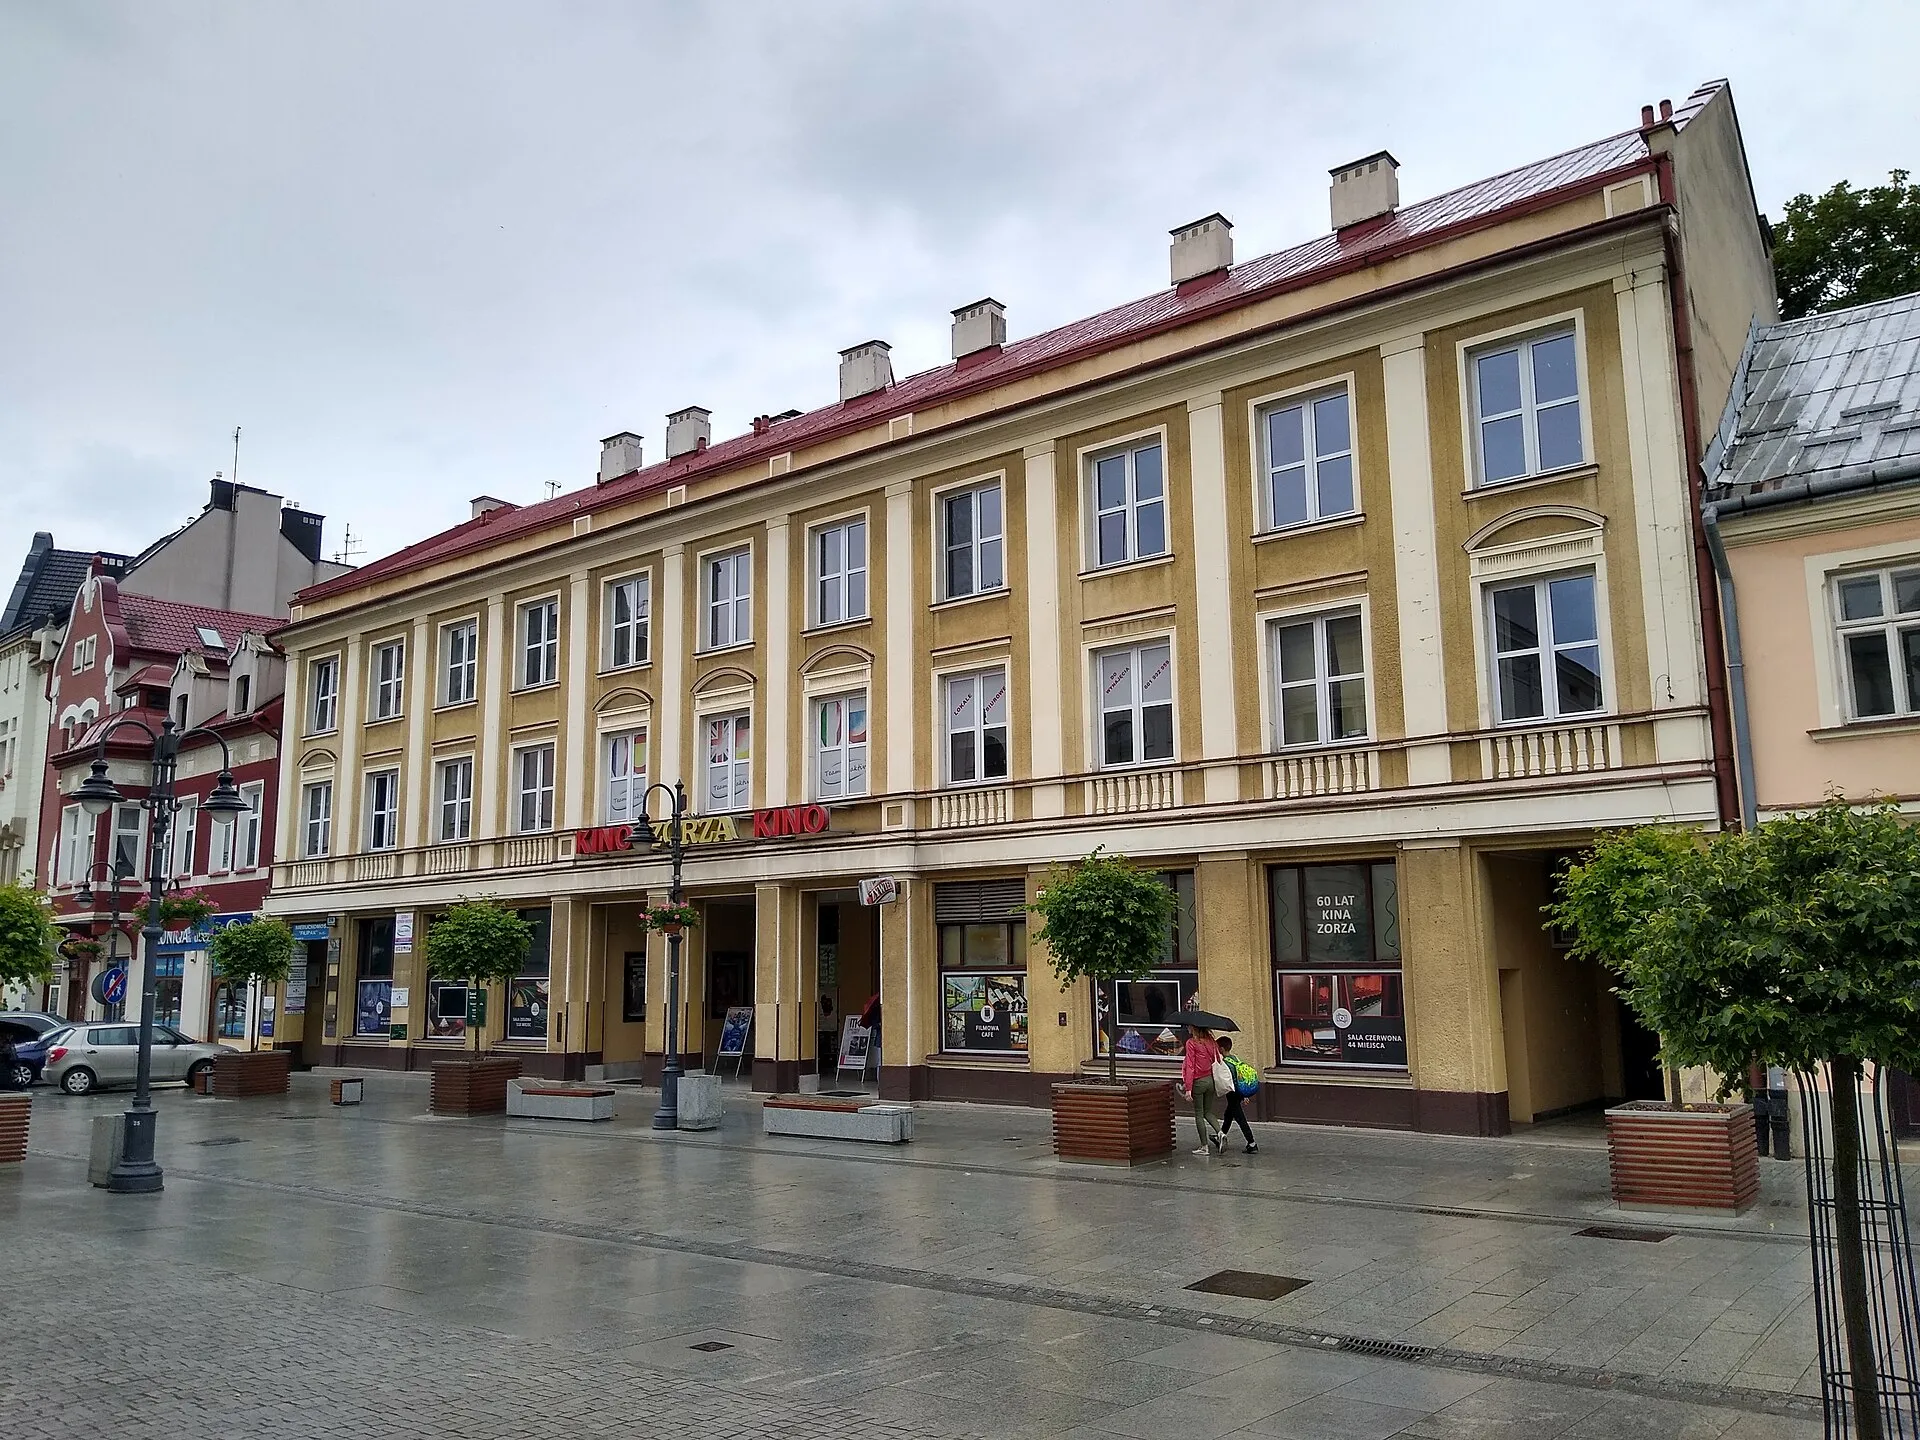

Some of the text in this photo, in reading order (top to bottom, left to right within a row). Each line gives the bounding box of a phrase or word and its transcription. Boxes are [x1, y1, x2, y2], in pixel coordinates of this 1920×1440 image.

[576, 825, 634, 855] KINO
[753, 804, 829, 838] KINO
[1316, 895, 1355, 907] 60 LAT
[1322, 909, 1352, 920] KINA
[1317, 922, 1357, 934] ZORZA
[1364, 1034, 1403, 1042] CZERWONA
